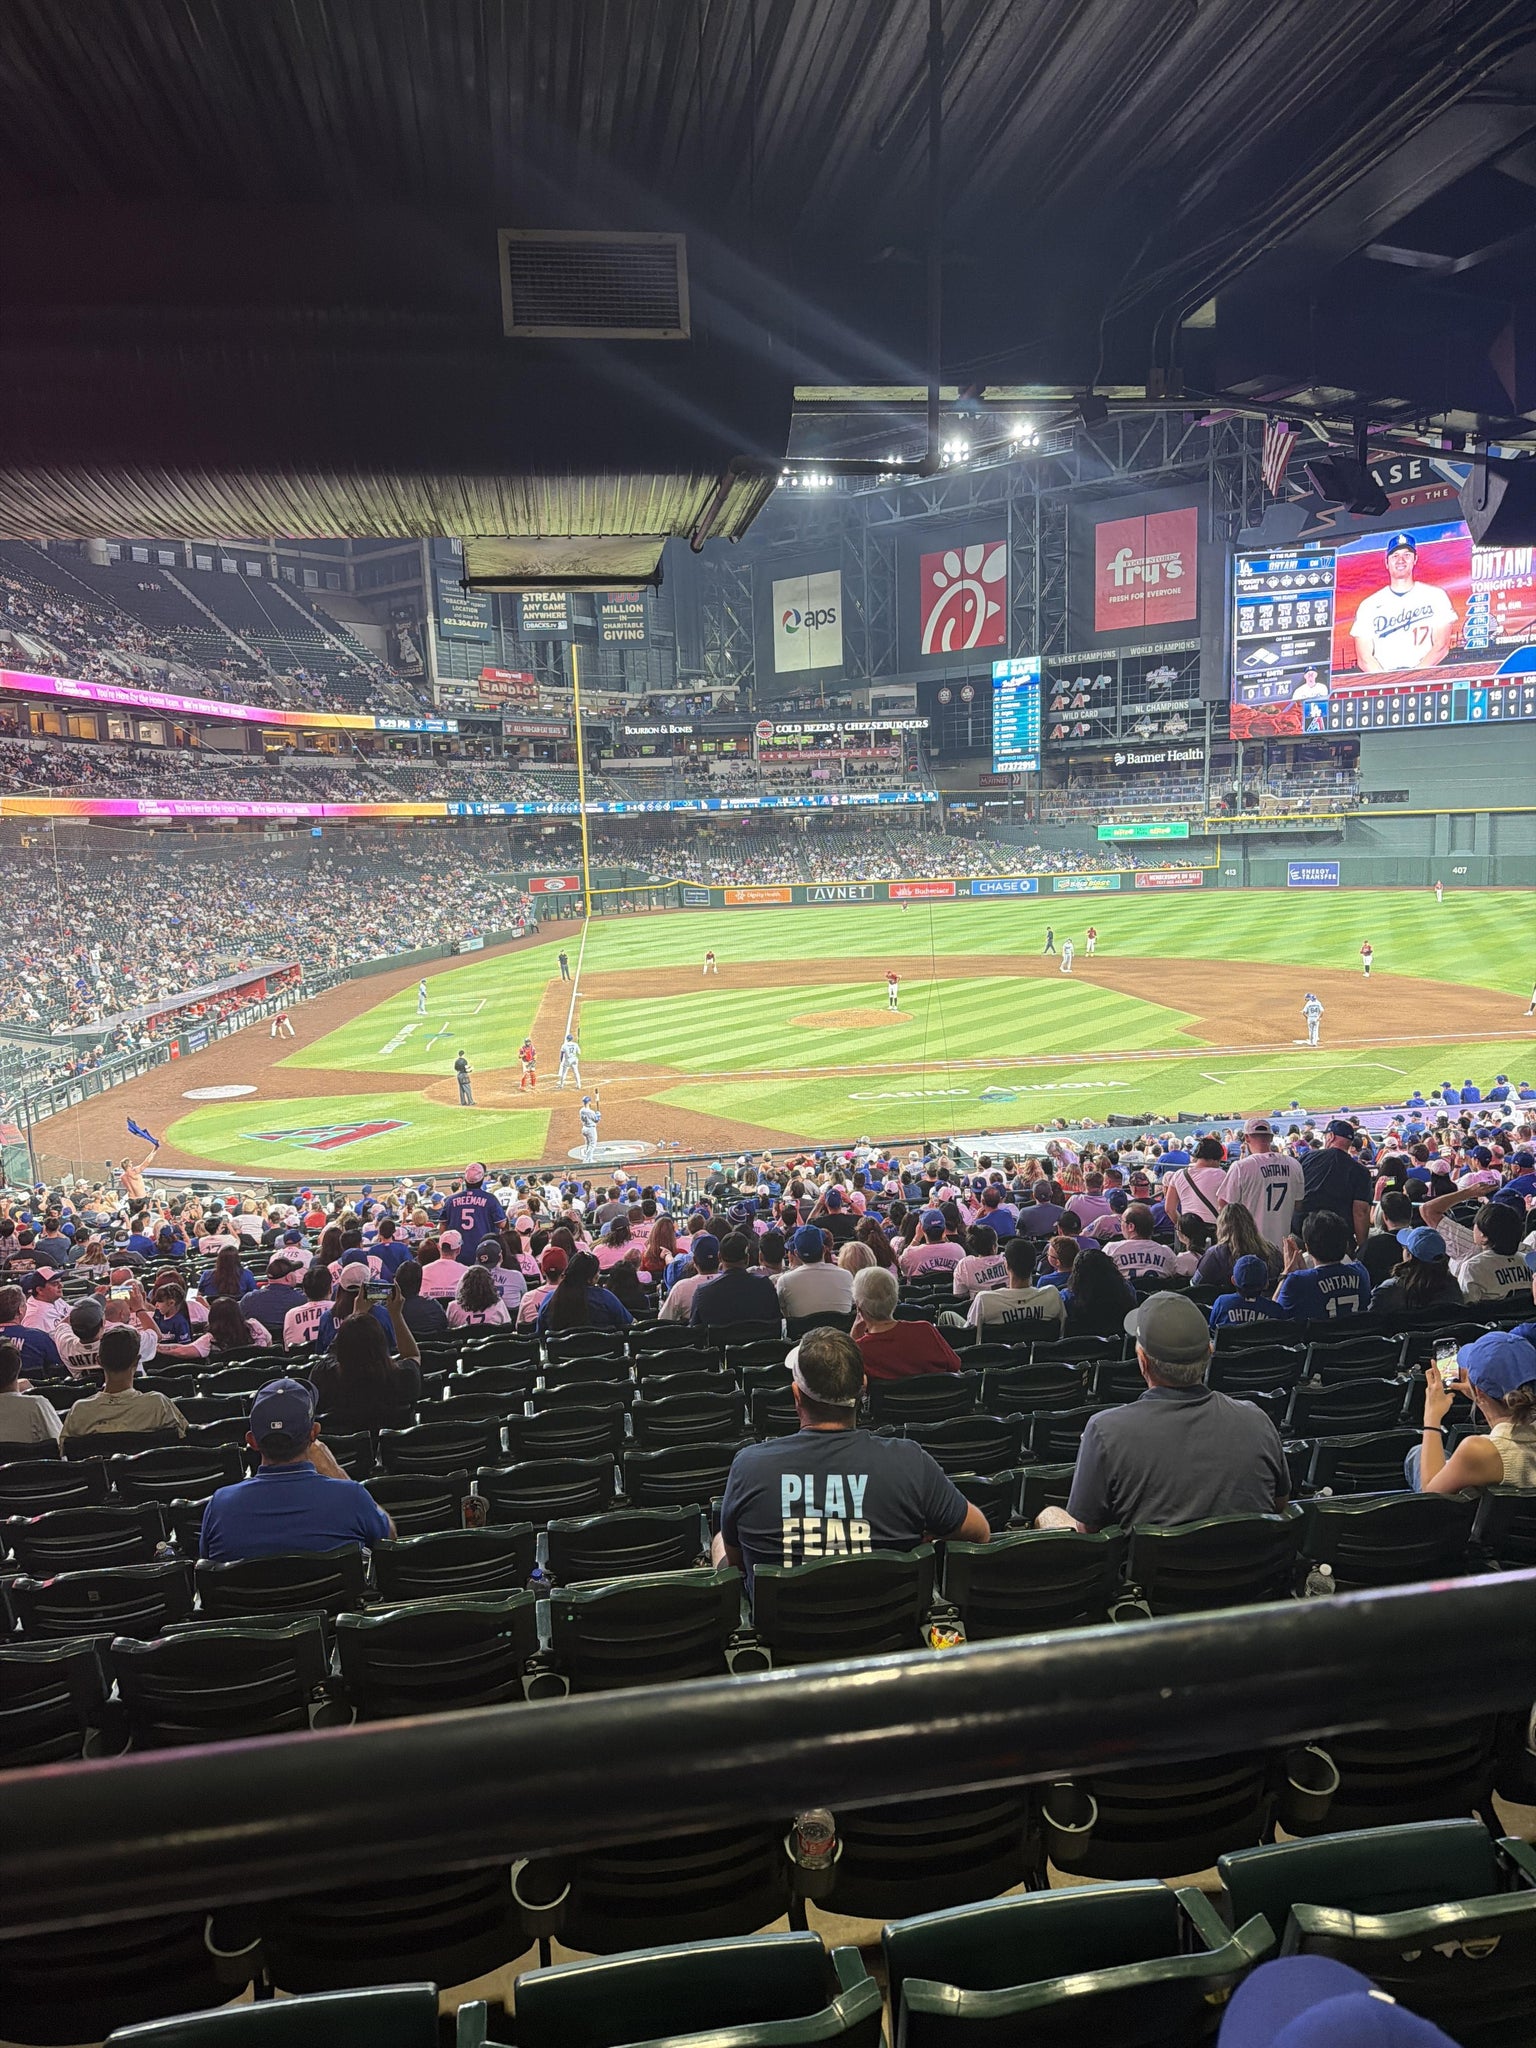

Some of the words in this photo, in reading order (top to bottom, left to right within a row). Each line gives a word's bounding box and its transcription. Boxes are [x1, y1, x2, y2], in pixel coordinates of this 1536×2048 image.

[1401, 495, 1415, 505] OF
[1426, 489, 1449, 499] THE
[1269, 560, 1298, 570] OHTANI
[1321, 556, 1331, 567] 17
[1472, 548, 1532, 580] OHTANI
[1471, 581, 1515, 593] TONIGHT:
[1516, 577, 1532, 588] 2-3
[522, 593, 566, 602] STREAM
[1109, 594, 1129, 603] FRESH
[1131, 592, 1144, 600] FOR
[1147, 587, 1181, 598] EVERYONE
[452, 606, 478, 614] LOCATION
[543, 603, 566, 611] GAME
[602, 604, 643, 614] MILLION
[444, 618, 488, 629] 623.304.0777
[524, 612, 567, 620] ANYWHERE
[804, 608, 836, 630] aps
[1374, 605, 1434, 634] Dodgers
[603, 630, 645, 640] GIVING
[1413, 626, 1429, 646] 17
[1130, 646, 1153, 655] WORLD
[1155, 641, 1195, 652] CHAMPIONS
[1049, 657, 1057, 665] NL
[1058, 655, 1076, 663] WEST
[1078, 650, 1116, 661] CHAMPIONS
[482, 681, 539, 696] SANDLOT
[1248, 689, 1254, 699] 0
[1264, 687, 1270, 697] 0
[1135, 705, 1145, 713] NL
[1147, 701, 1189, 712] CHAMPIONS
[1332, 703, 1339, 713] 0
[1347, 702, 1353, 711] 2
[1362, 701, 1368, 710] 3
[1377, 700, 1384, 709] 0
[1393, 698, 1399, 708] 0
[1409, 697, 1415, 707] 0
[1425, 696, 1431, 706] 2
[1441, 695, 1448, 704] 0
[1473, 692, 1482, 703] 7
[1490, 691, 1502, 700] 15
[1509, 690, 1516, 699] 0
[1524, 688, 1534, 698] 11
[1062, 712, 1078, 720] WILD
[1081, 710, 1098, 718] CARD
[1332, 718, 1338, 728] 0
[1346, 717, 1353, 726] 0
[1362, 716, 1368, 725] 0
[1377, 715, 1384, 724] 0
[1392, 714, 1399, 723] 0
[1408, 712, 1415, 722] 0
[1424, 711, 1431, 721] 0
[1441, 710, 1448, 720] 0
[1473, 707, 1481, 718] 0
[1492, 706, 1499, 716] 2
[1509, 705, 1515, 714] 1
[1525, 704, 1532, 713] 3
[398, 720, 410, 728] PM
[625, 726, 659, 735] BOURBON
[661, 725, 668, 733] &
[670, 725, 693, 734] BONES
[776, 725, 801, 733] COLD
[804, 723, 835, 732] BEERS
[837, 723, 843, 731] &
[845, 720, 928, 731] CHEESEBURGERS
[1127, 752, 1165, 764] Banner
[1167, 748, 1203, 761] Health
[814, 886, 867, 899] AVNET
[914, 887, 949, 895] Budweiser
[980, 882, 1018, 892] CHASE
[848, 1088, 970, 1100] CASINO
[982, 1081, 1130, 1093] ARIZONA
[1261, 1162, 1290, 1178] OHTANI
[452, 1196, 487, 1208] FREEMAN
[1266, 1183, 1288, 1211] 17
[461, 1208, 475, 1230] 5
[1120, 1253, 1166, 1267] OHTANI
[1495, 1266, 1533, 1285] OHTAN
[1318, 1275, 1360, 1294] OHTANI
[1003, 1305, 1044, 1323] OHTANI
[1325, 1295, 1360, 1318] 17
[295, 1307, 325, 1325] OHTA
[781, 1474, 869, 1518] PLAY
[782, 1518, 872, 1555] FEAR
